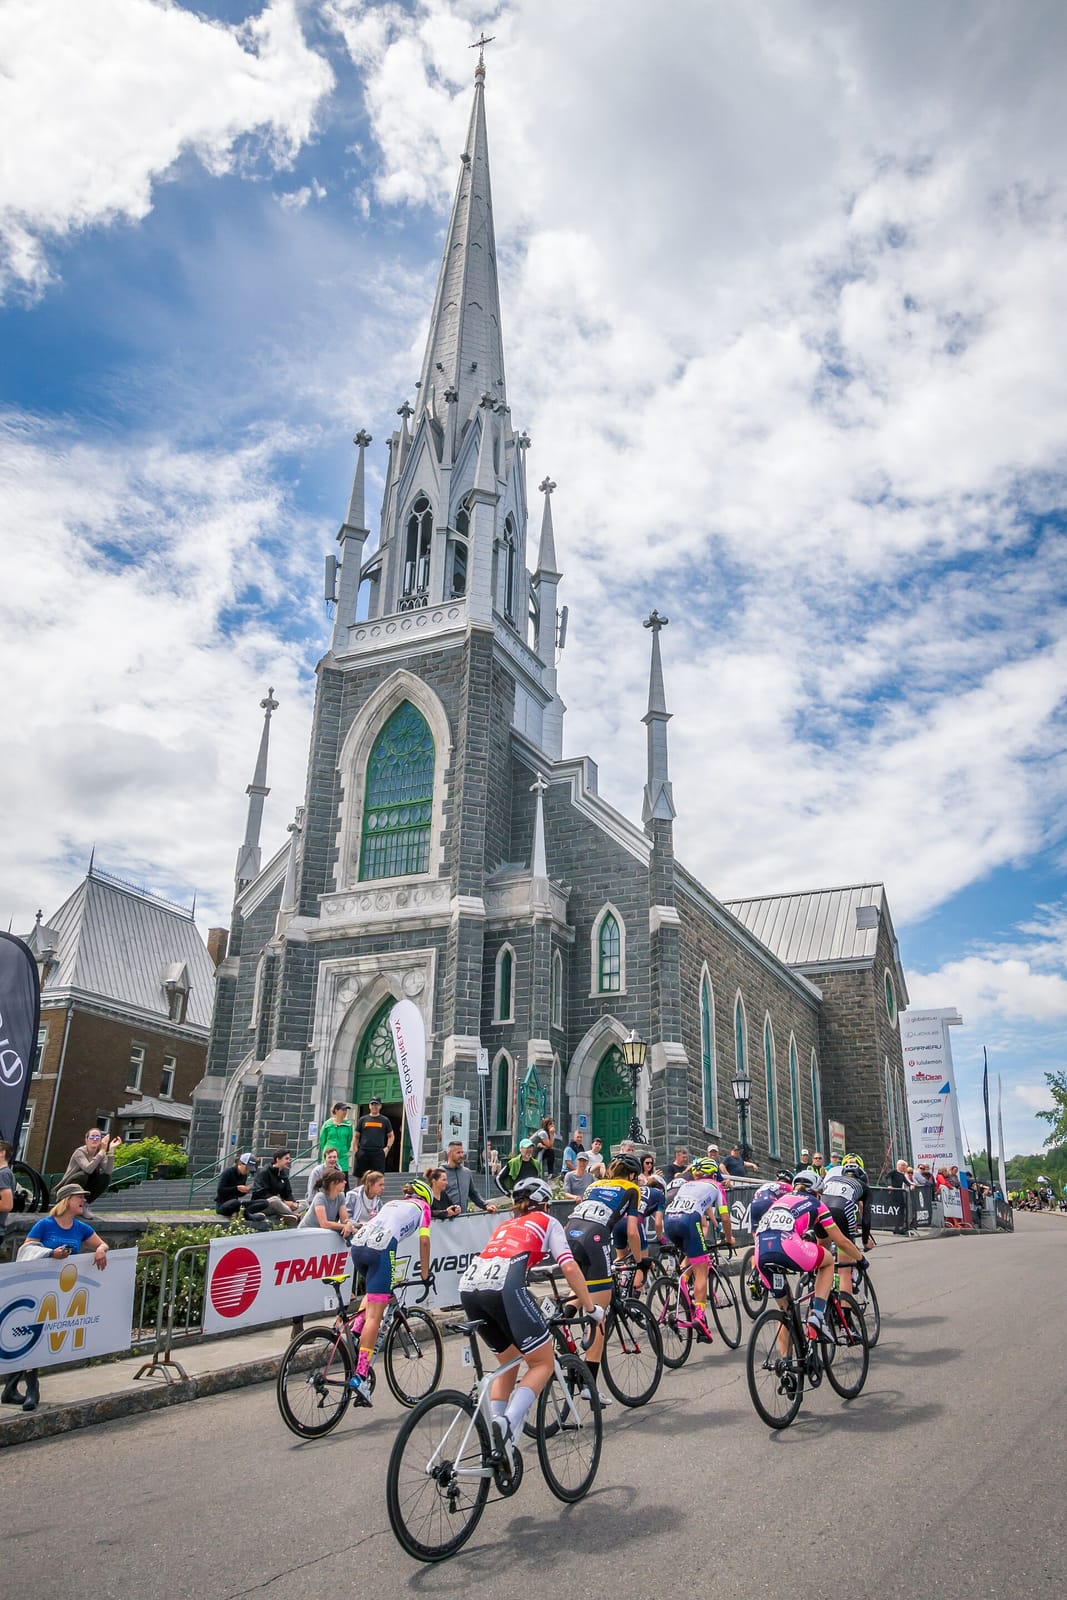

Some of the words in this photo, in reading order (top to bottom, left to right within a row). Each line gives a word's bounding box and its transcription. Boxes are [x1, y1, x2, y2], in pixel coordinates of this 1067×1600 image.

[917, 1152, 953, 1160] GARDAWORLD
[841, 1186, 847, 1194] 9
[870, 1204, 901, 1216] RELAY
[772, 1214, 793, 1225] 200
[375, 1232, 384, 1243] 8
[274, 1251, 348, 1286] TRANE
[483, 1264, 501, 1281] 42
[44, 1315, 101, 1332] INFORMATIQUE
